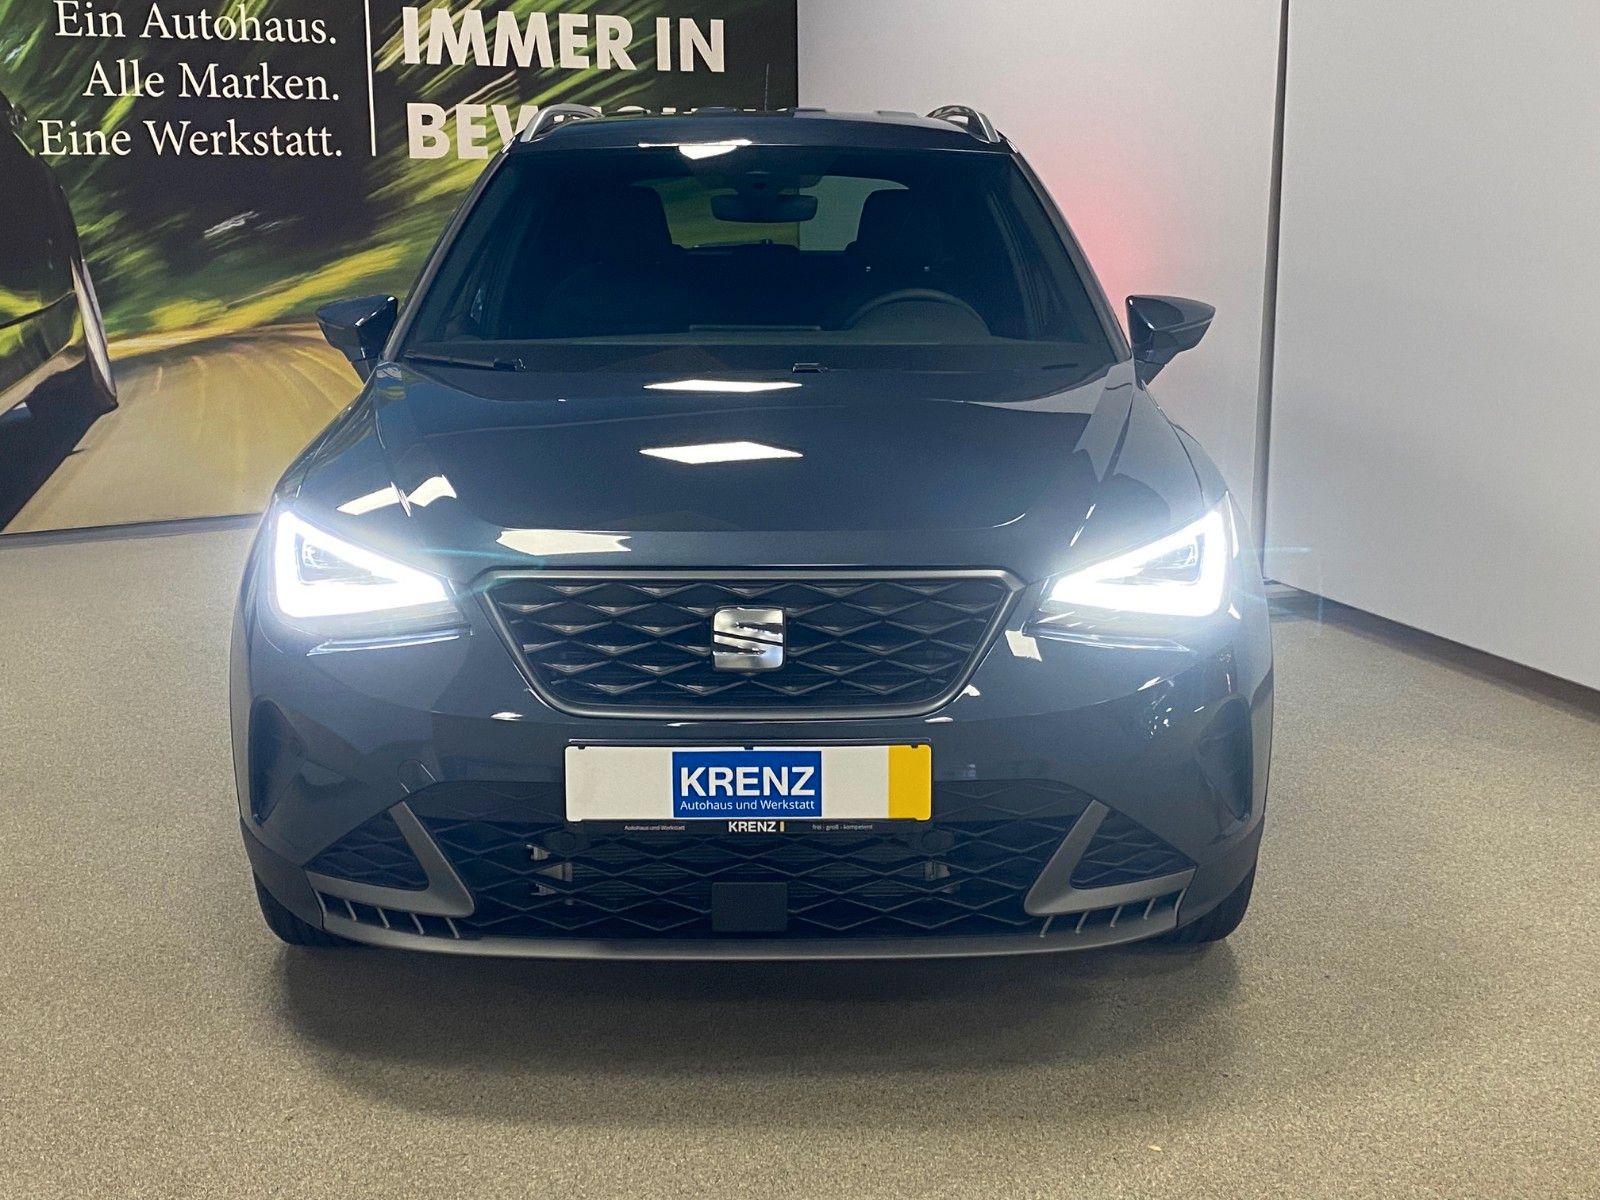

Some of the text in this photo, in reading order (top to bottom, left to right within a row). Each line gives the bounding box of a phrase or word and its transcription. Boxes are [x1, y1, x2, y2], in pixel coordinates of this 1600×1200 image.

[54, 0, 337, 45] Ein Autohaus.
[402, 6, 725, 73] IMMER IN
[82, 59, 340, 101] Alle Marken.
[37, 119, 343, 157] Eine Werkstatt.
[680, 766, 816, 797] KRENZ
[680, 799, 815, 810] Autohaus und Werkstatt
[728, 821, 777, 833] KRENZ
